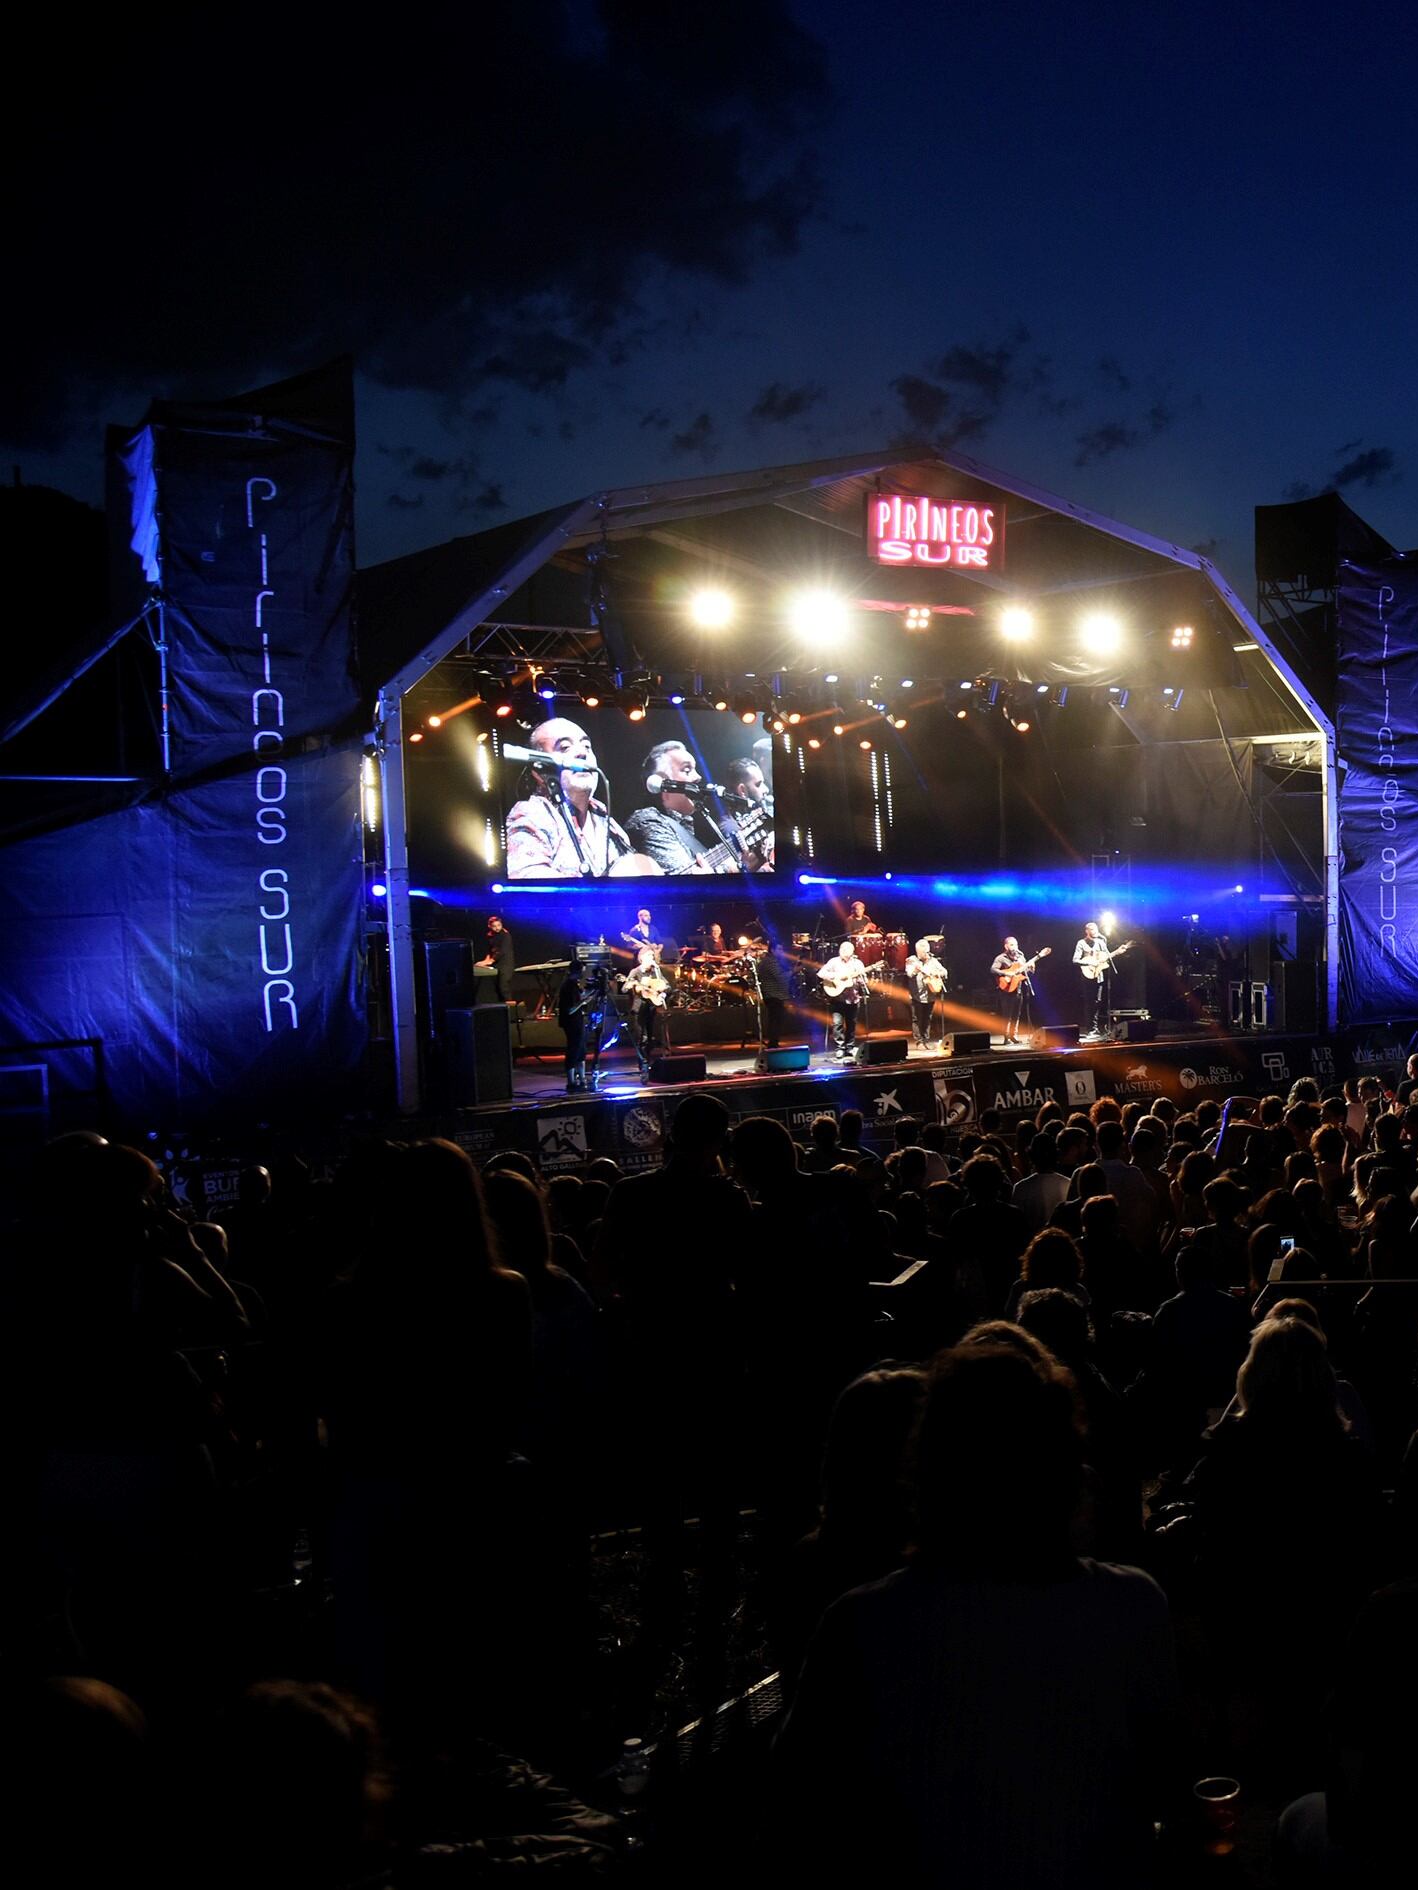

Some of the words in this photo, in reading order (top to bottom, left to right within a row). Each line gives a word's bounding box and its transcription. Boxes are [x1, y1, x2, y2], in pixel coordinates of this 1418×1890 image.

[877, 496, 995, 546] PIRINEOS
[878, 541, 989, 567] SUR
[1379, 846, 1398, 958] SUR
[258, 868, 298, 1033] SUR
[993, 1087, 1056, 1110] AMBAR
